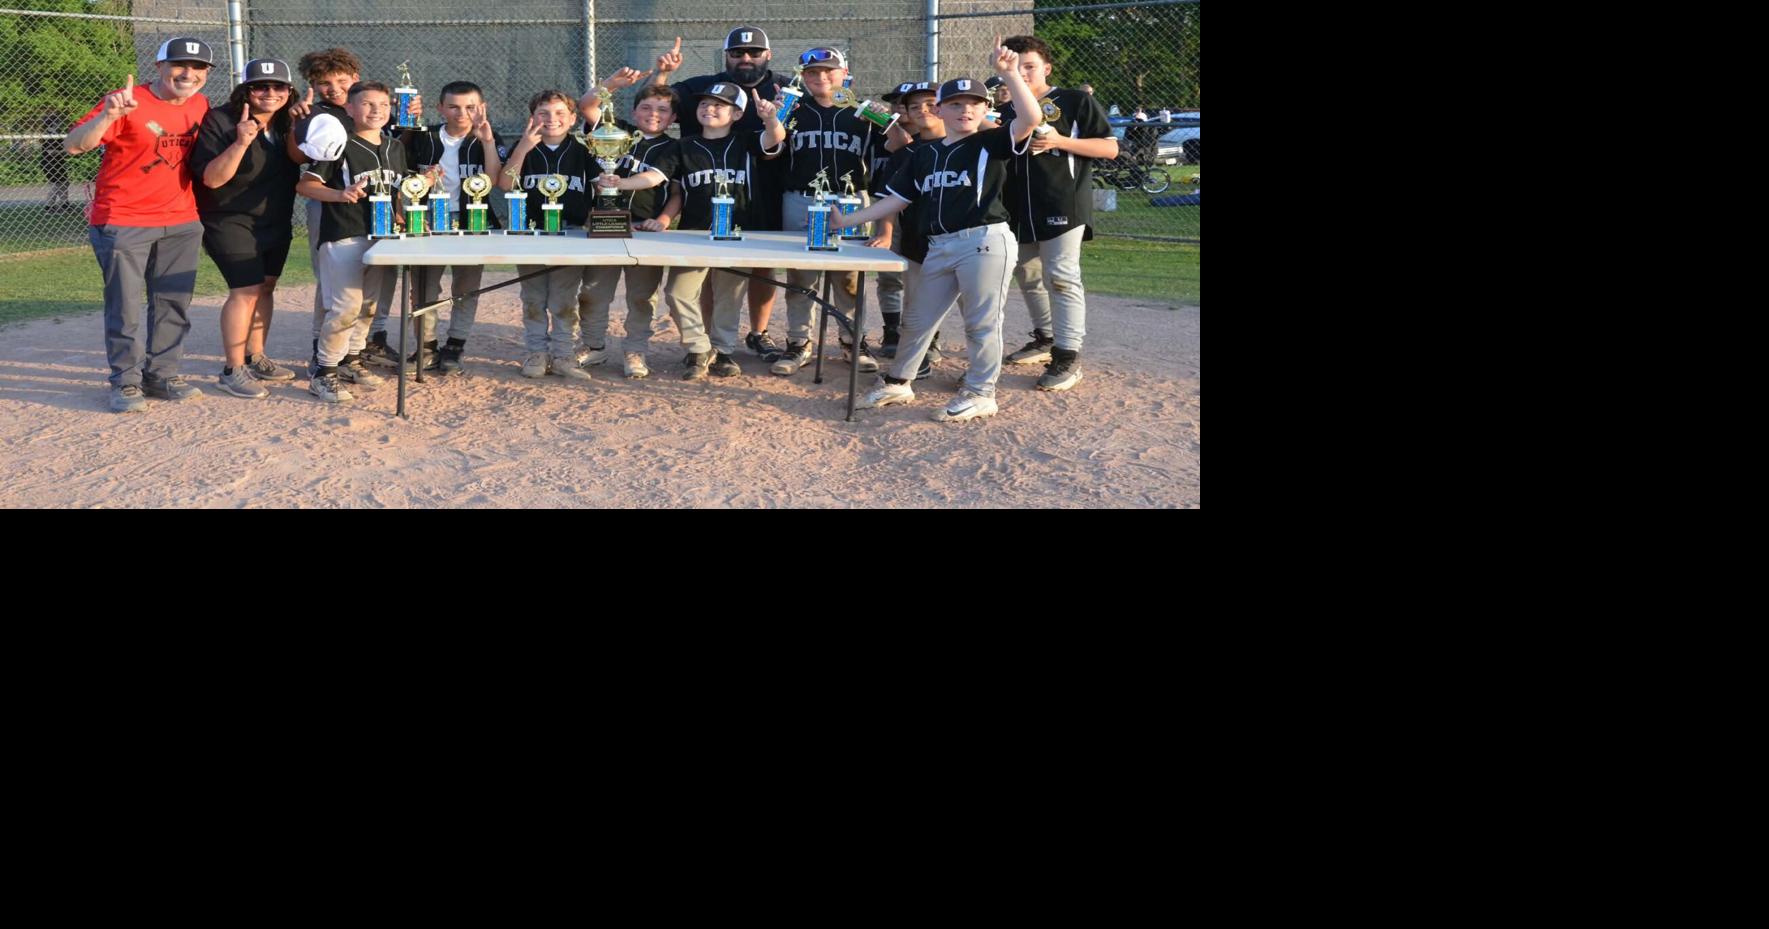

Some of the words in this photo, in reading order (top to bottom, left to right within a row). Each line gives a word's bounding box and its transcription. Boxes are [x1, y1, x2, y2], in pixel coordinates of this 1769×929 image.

[740, 31, 753, 43] U
[186, 42, 200, 55] U
[261, 62, 275, 74] U
[711, 84, 725, 95] U
[957, 79, 971, 91] U
[793, 130, 861, 156] UTICA
